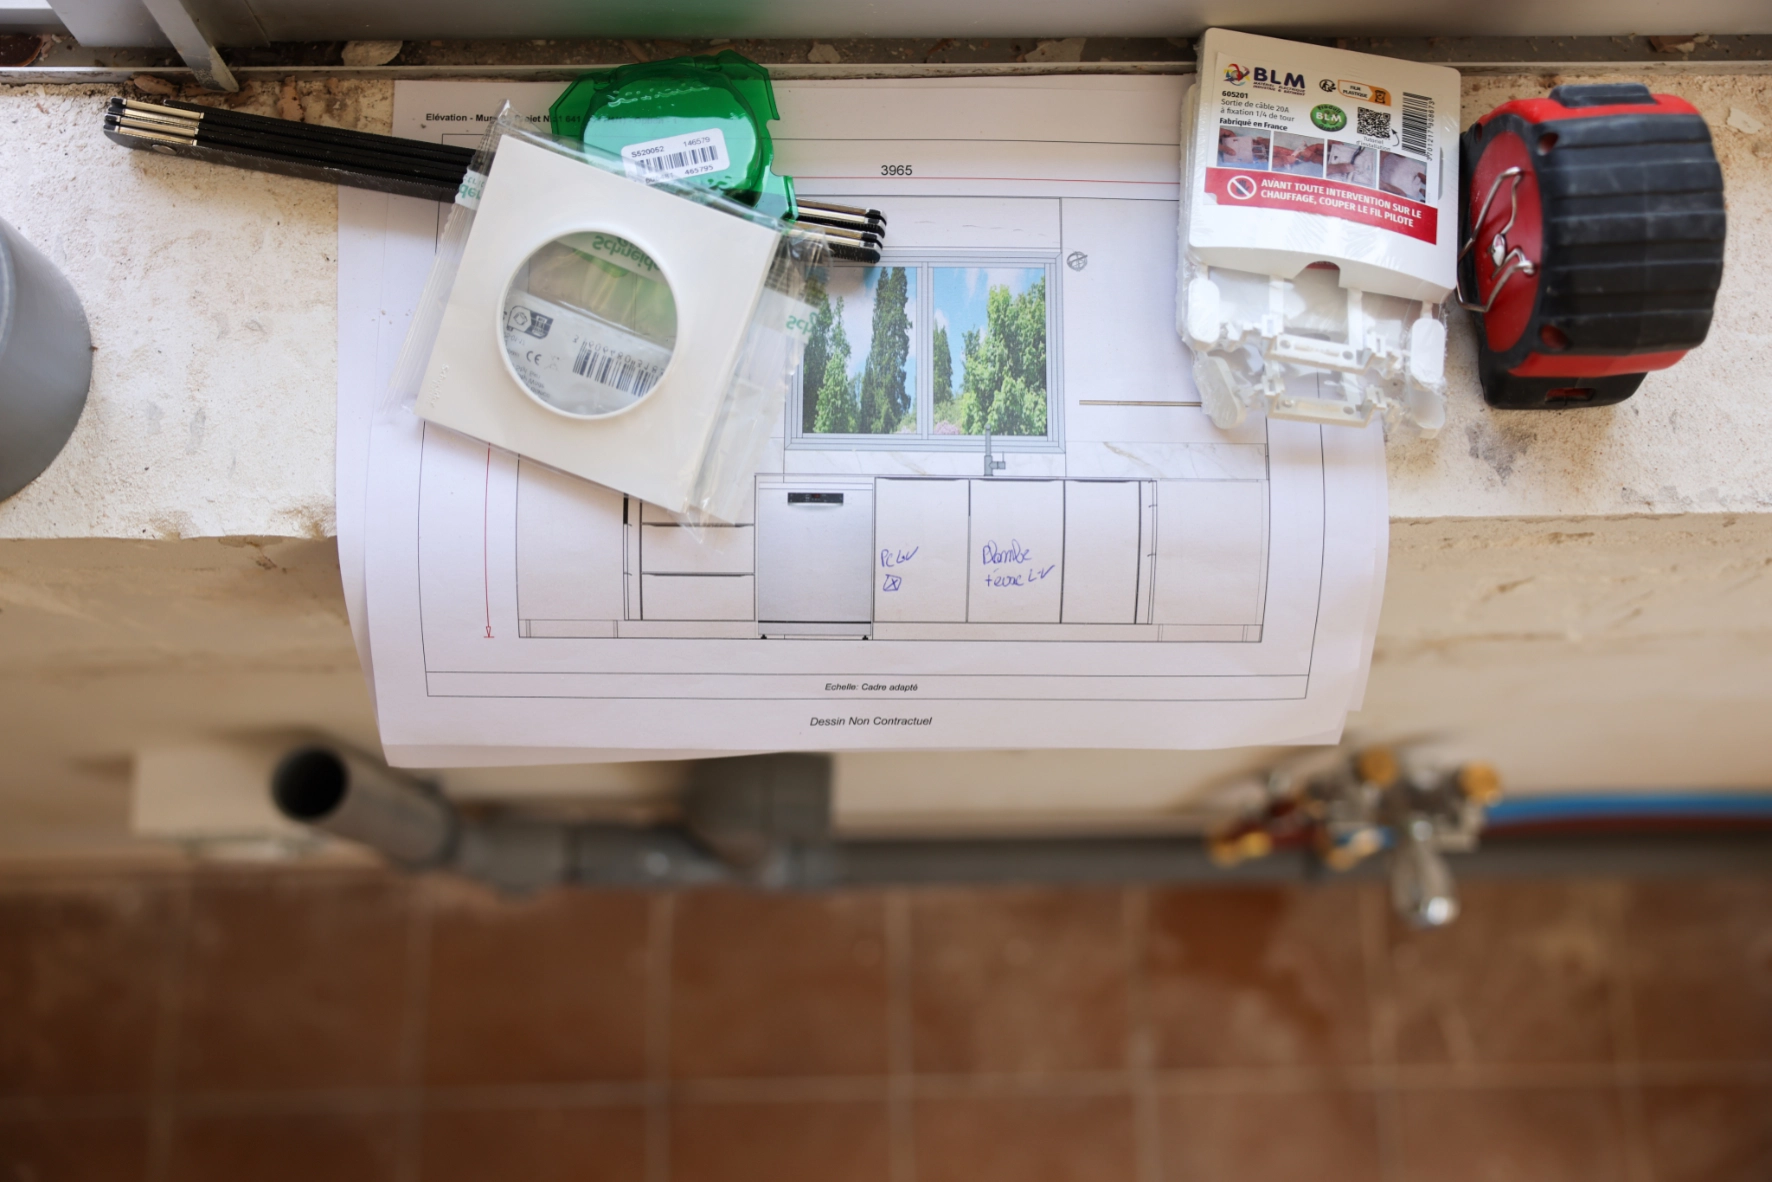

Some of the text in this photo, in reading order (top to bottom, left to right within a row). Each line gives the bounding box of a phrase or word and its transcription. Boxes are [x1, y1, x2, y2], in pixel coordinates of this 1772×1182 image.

[1254, 66, 1305, 89] BLM
[1222, 90, 1249, 99] 605201
[1220, 99, 1243, 107] Sortie
[1255, 102, 1275, 111] câble
[1276, 105, 1290, 113] 20A
[425, 113, 468, 122] Elévation
[566, 114, 581, 124] 641
[1226, 107, 1254, 116] fixation
[1256, 110, 1267, 118] 1/4
[1279, 114, 1295, 122] tour
[1315, 111, 1342, 122] BLM
[1219, 117, 1252, 127] Fabriqué
[1264, 122, 1288, 131] France
[631, 136, 711, 158] S520052 146579
[684, 165, 714, 176] 465795
[881, 164, 913, 176] 3965
[1261, 178, 1422, 219] AVANT TOUTE INTERVENTION SUR LE
[1260, 190, 1414, 228] CHAUFFAGE, COUPER LE FIL PILOTE
[880, 548, 895, 567] PC
[824, 682, 918, 693] Echelle: Cadre adapté
[809, 716, 933, 727] Dessin Non Contractuel
